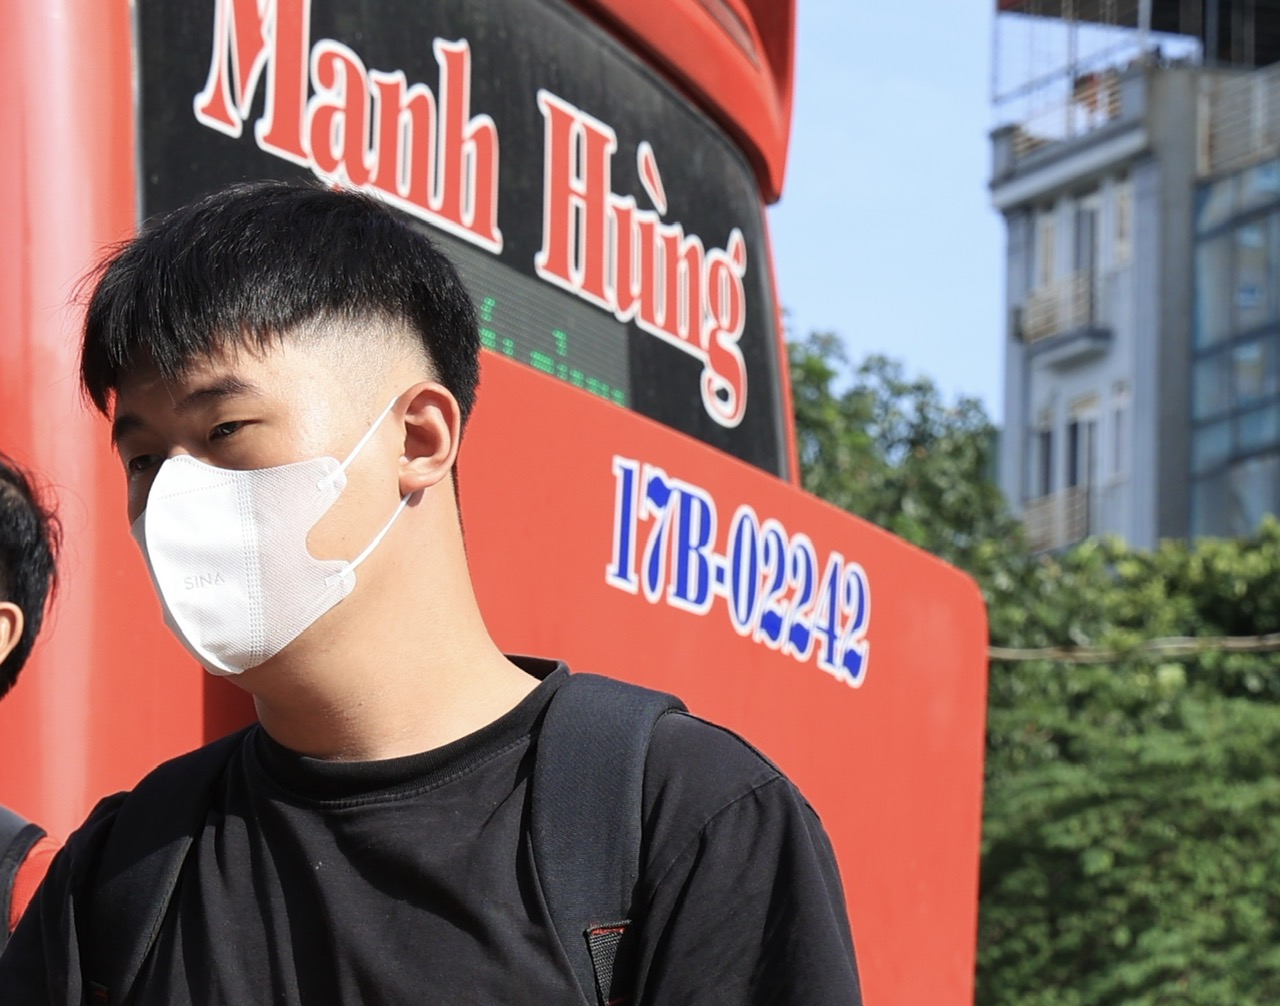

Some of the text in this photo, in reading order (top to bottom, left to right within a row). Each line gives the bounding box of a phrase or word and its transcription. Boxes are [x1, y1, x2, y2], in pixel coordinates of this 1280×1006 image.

[535, 89, 748, 428] Hùng
[184, 571, 225, 590] SINA
[607, 456, 871, 687] 17B-02242
